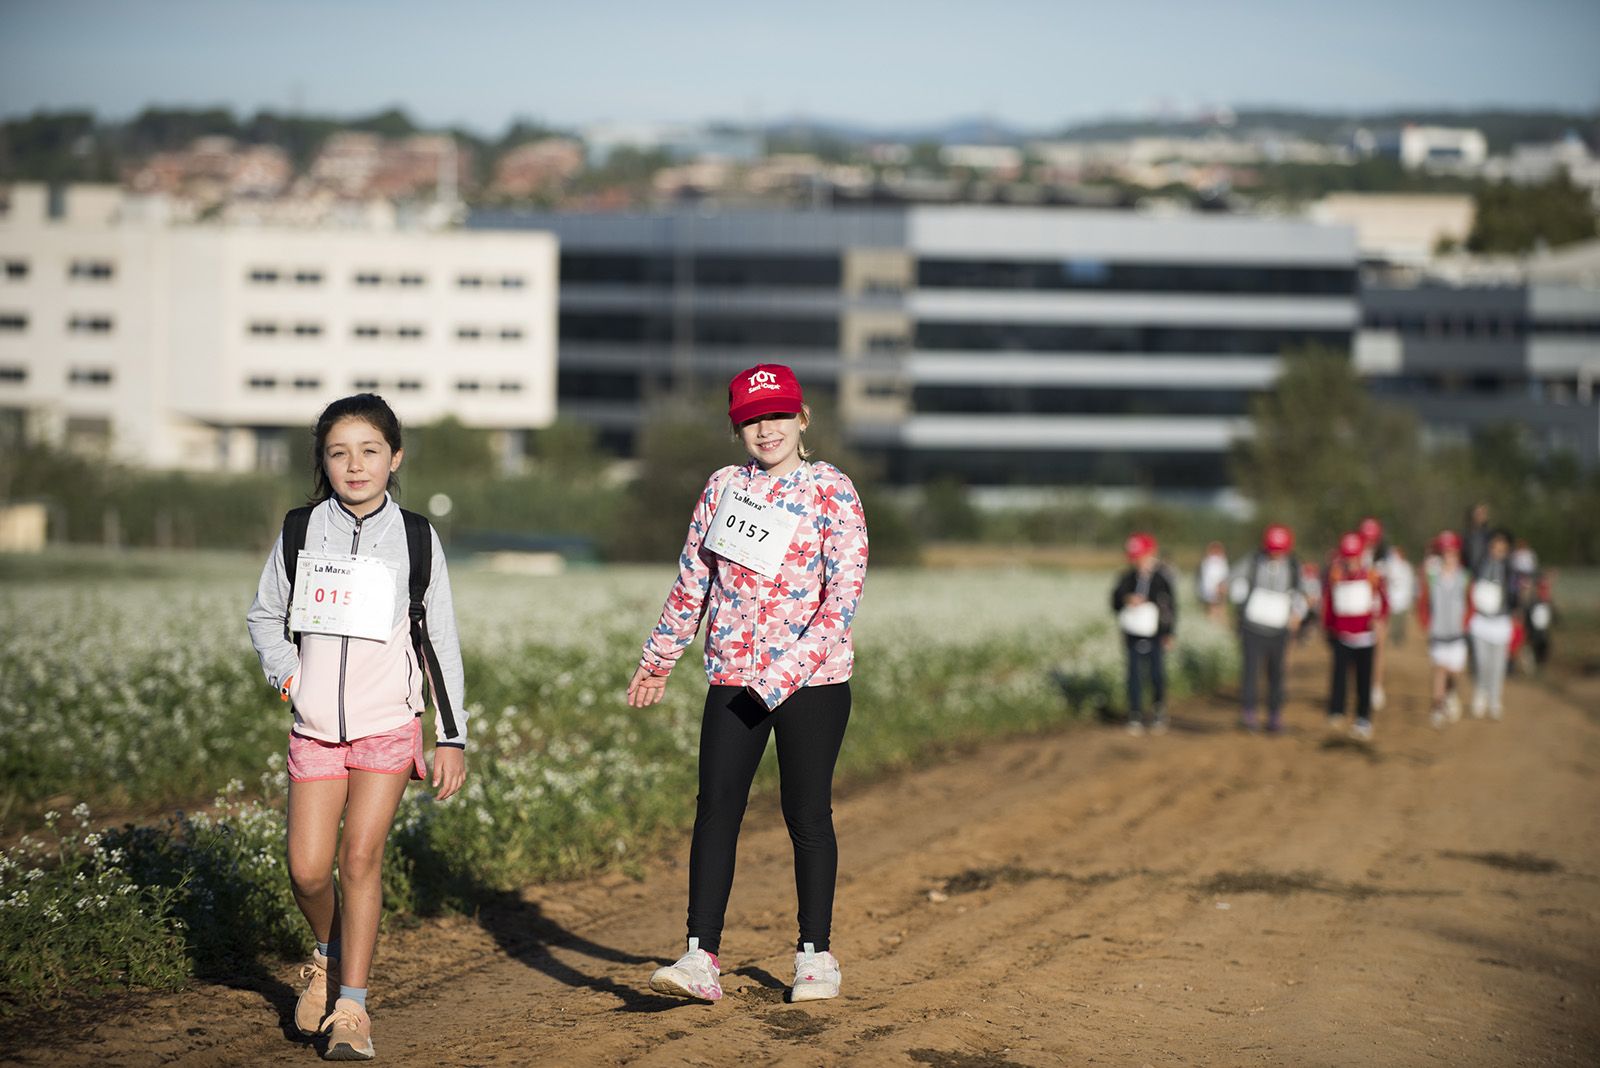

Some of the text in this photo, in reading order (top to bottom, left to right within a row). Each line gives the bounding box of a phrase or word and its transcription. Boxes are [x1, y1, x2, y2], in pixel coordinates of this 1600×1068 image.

[748, 370, 777, 386] TOT
[732, 491, 743, 502] "La
[726, 515, 770, 543] 0157
[315, 588, 363, 607] 015
